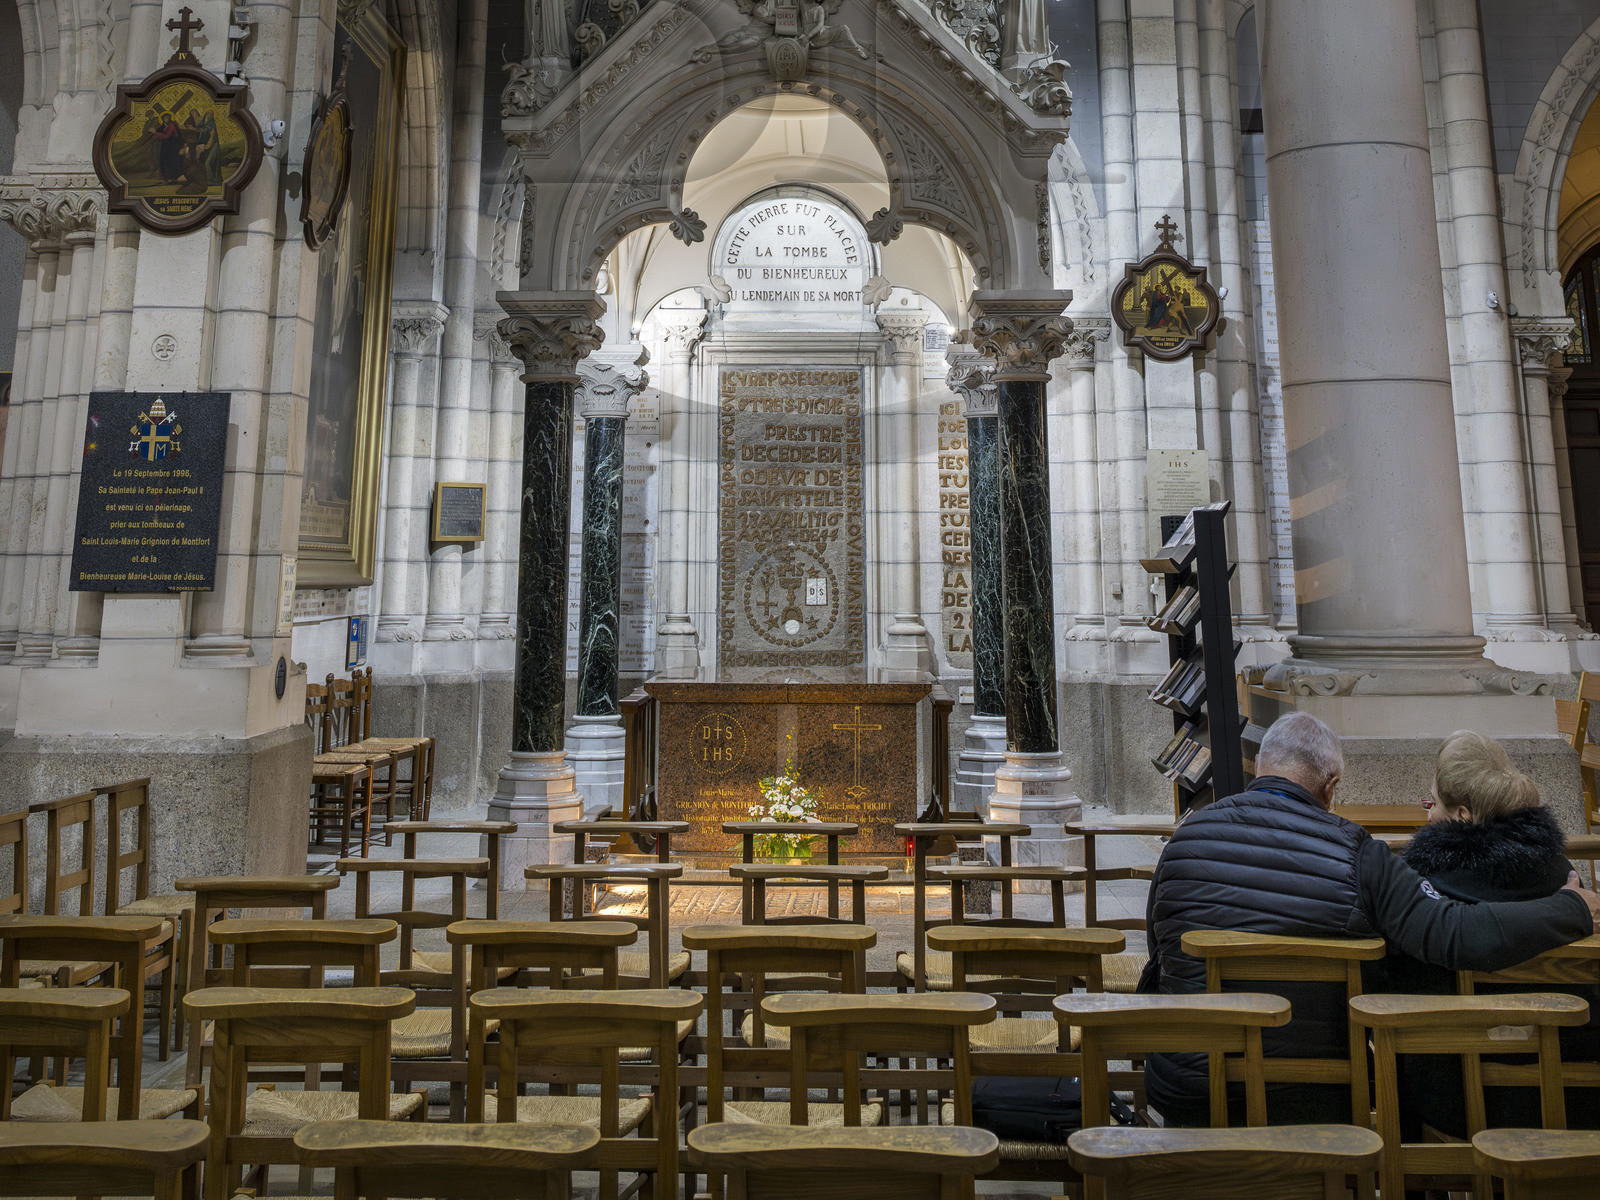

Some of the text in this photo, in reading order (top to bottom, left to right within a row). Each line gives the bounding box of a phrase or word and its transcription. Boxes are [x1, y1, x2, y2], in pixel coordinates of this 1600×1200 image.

[179, 52, 187, 60] IV
[727, 227, 750, 265] CETTE
[748, 203, 789, 228] PIERRE
[796, 203, 821, 218] FUT
[777, 225, 806, 235] SUR
[756, 246, 828, 258] LA TOMBE
[737, 268, 848, 280] DU BIENHEUREUX
[729, 291, 861, 301] U LENDEMAIN DE SA MORT
[939, 402, 960, 415] ICI
[113, 469, 122, 477] Le
[124, 469, 132, 477] 19
[134, 469, 170, 479] Septembre
[98, 486, 107, 494] Sa
[108, 486, 137, 494] Sainteté
[146, 486, 163, 496] Pape
[164, 486, 198, 495] Jean-Paul
[110, 521, 127, 530] prier
[141, 520, 175, 529] tombeaux
[176, 520, 185, 528] de
[81, 537, 210, 547] Saint Louis-Marie Grignion de Montfort
[131, 555, 157, 563] et de la
[79, 572, 205, 580] Bienheureuse Marie-Louise de Jésus.
[943, 572, 968, 588] LA
[703, 747, 733, 761] IHS
[700, 788, 735, 796] Louis-Marie
[676, 801, 710, 809] GRIGNION
[721, 801, 757, 809] MONTFORT
[822, 802, 860, 810] Marie-Louise
